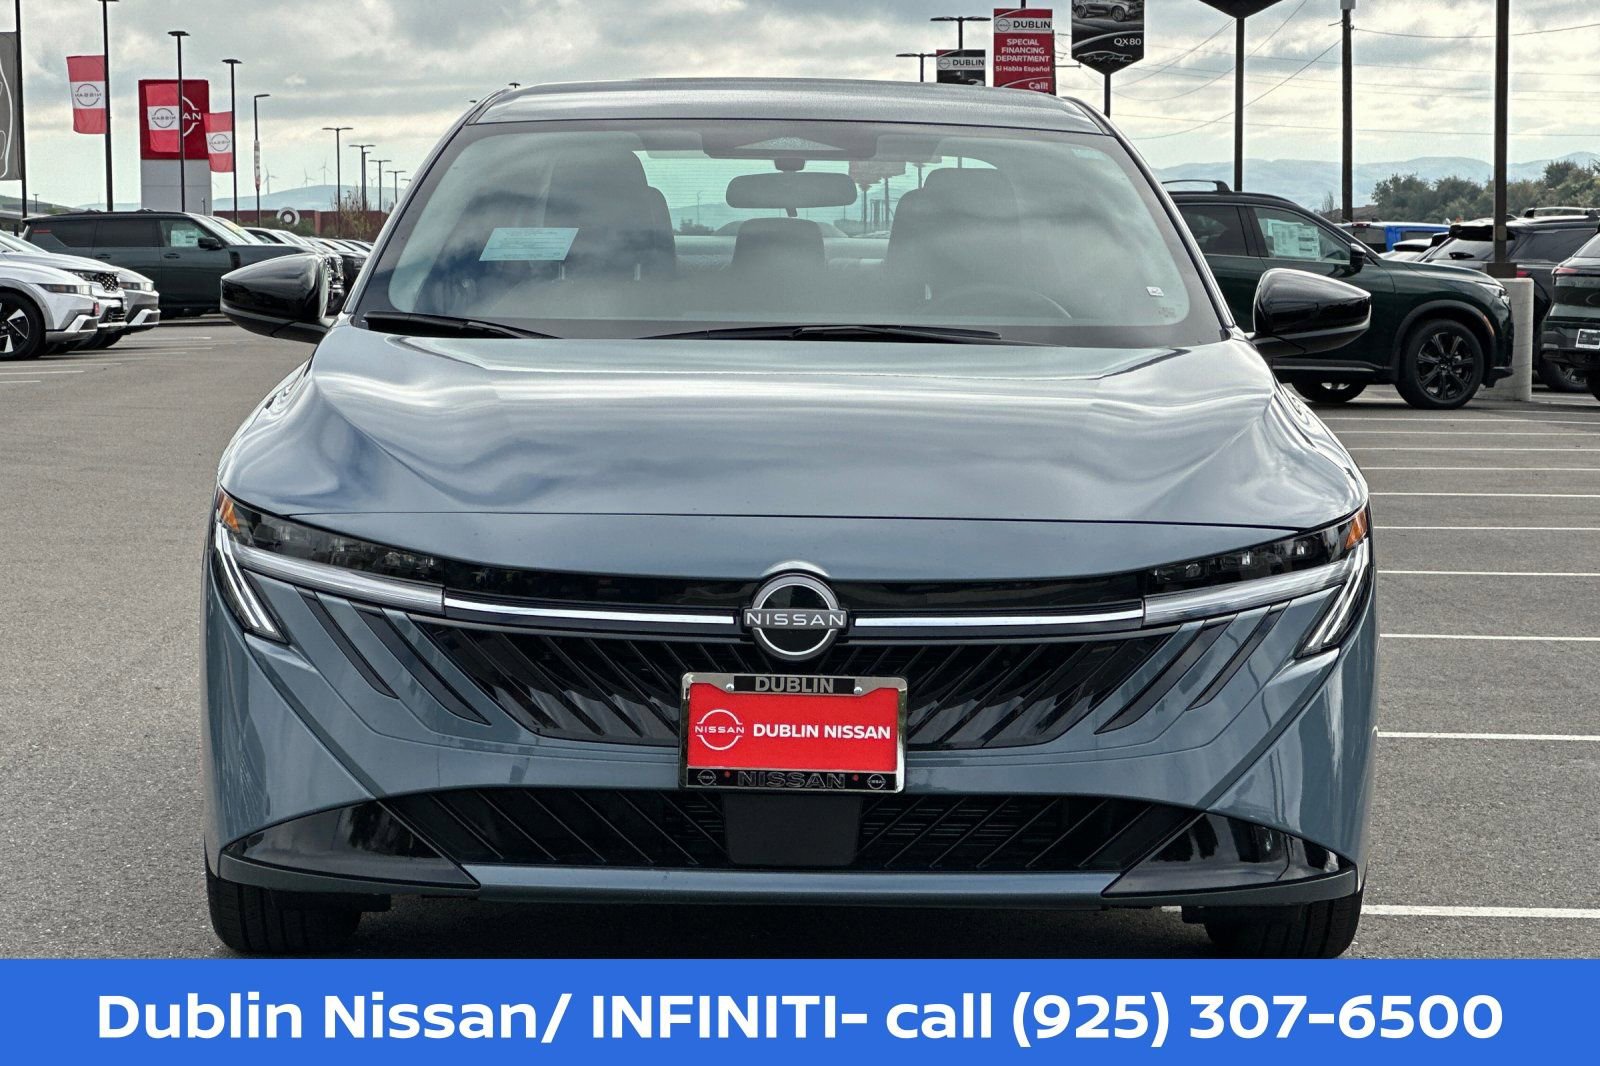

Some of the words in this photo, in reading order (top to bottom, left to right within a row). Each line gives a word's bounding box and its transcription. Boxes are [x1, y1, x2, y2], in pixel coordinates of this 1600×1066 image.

[1013, 20, 1051, 29] DUBLIN
[1006, 38, 1040, 46] SPECIAL
[1023, 65, 1050, 73] Español
[1028, 82, 1049, 90] Call!
[746, 612, 844, 627] NISSAN
[755, 676, 834, 693] DUBLIN
[695, 725, 745, 734] NISSAN
[753, 723, 819, 738] DUBLIN
[824, 724, 891, 740] NISSAN
[737, 770, 846, 789] NISSAN
